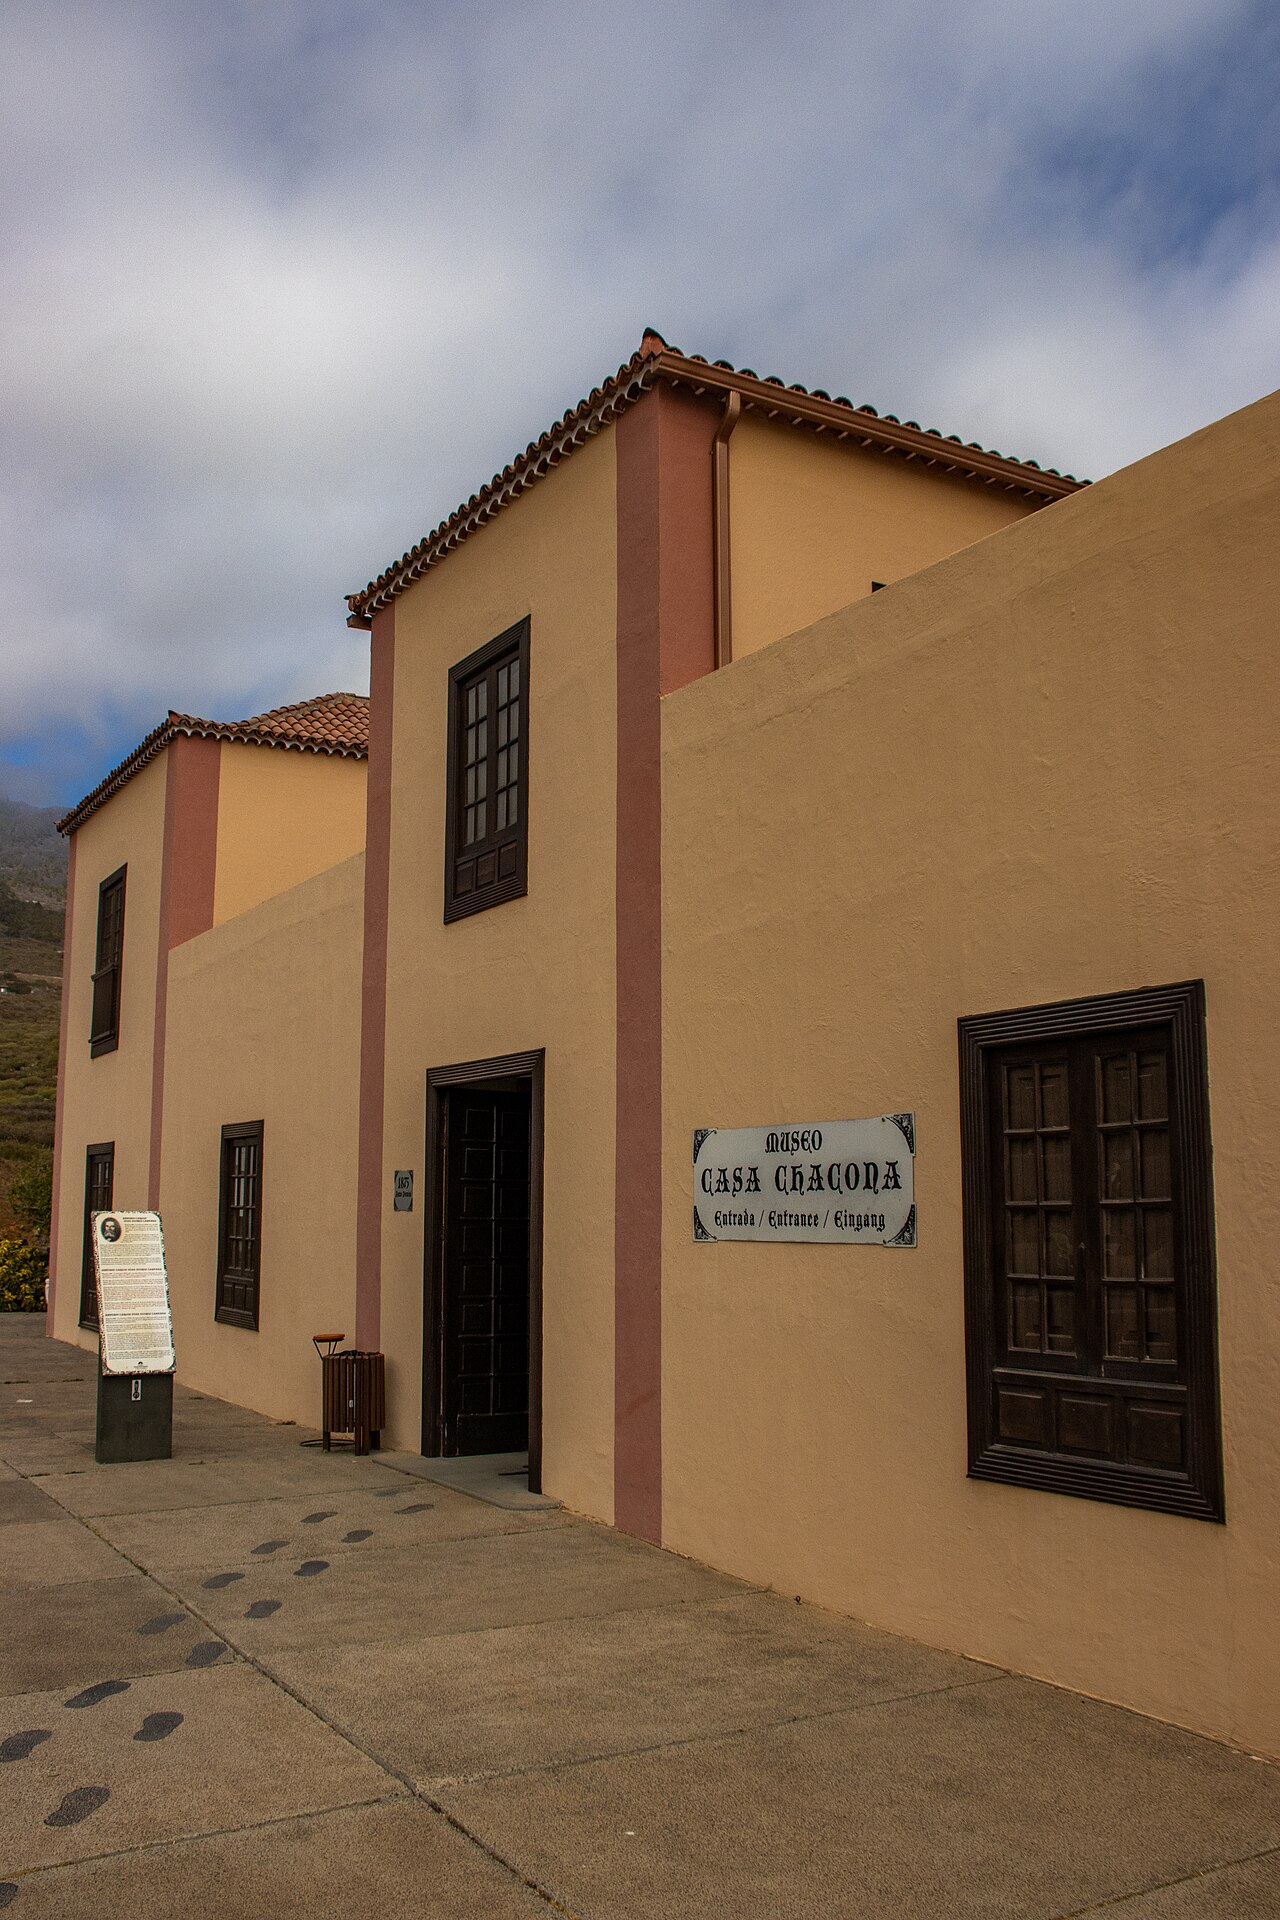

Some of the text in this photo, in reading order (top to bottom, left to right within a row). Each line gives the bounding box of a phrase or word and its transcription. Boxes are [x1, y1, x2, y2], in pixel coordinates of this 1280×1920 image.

[765, 1129, 823, 1156] MUSEO
[701, 1161, 903, 1197] CASA CHACONA
[714, 1209, 756, 1228] Entrada
[768, 1210, 819, 1230] Entrance
[834, 1210, 886, 1232] Eingang
